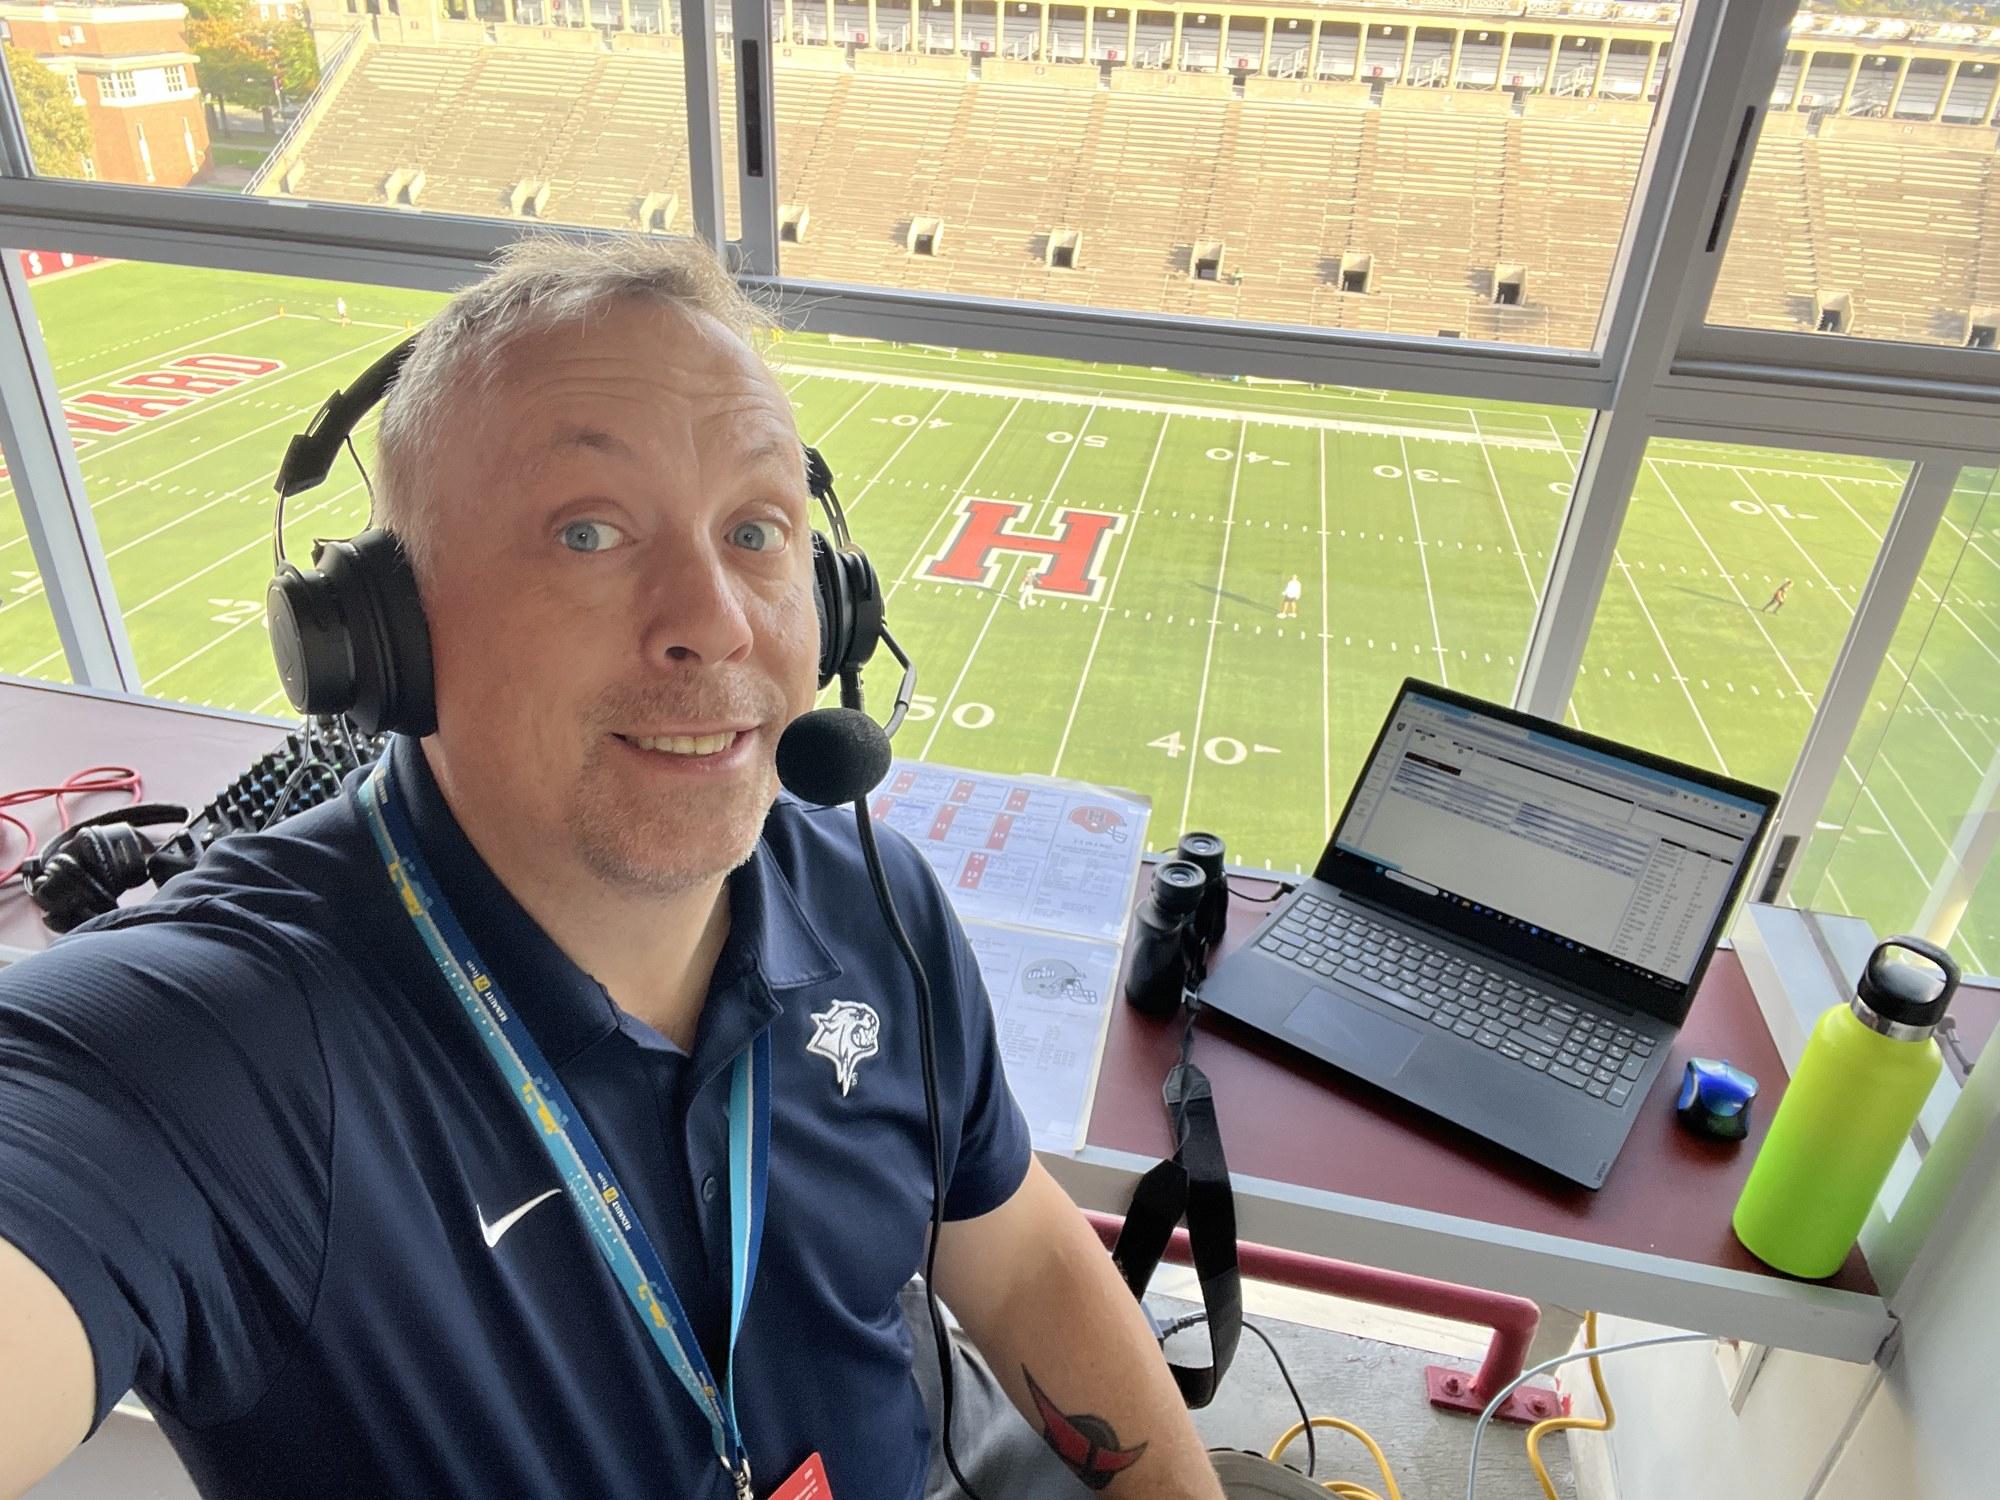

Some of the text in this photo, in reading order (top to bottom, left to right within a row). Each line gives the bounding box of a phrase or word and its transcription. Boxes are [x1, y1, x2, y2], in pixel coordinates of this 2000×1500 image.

[913, 496, 1128, 601] H
[904, 694, 995, 729] 50
[1146, 731, 1248, 765] 40
